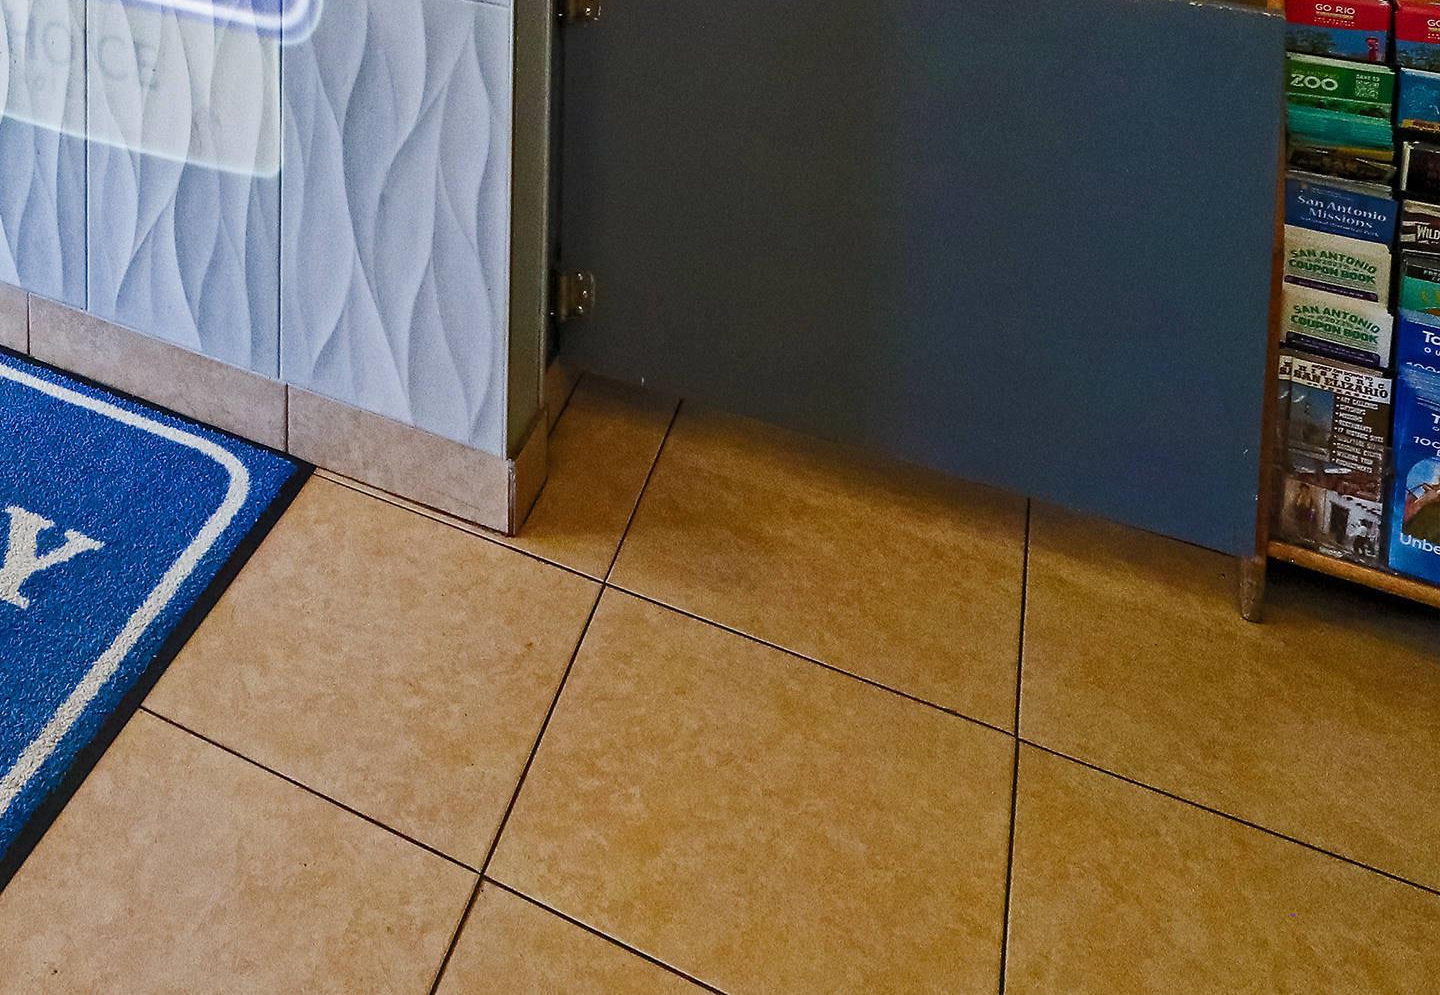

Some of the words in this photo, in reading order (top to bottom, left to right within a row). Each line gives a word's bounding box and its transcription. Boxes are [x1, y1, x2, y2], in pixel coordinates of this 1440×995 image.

[1315, 3, 1332, 12] GO
[1335, 5, 1356, 15] RIO
[1290, 73, 1338, 91] ZOO
[1297, 195, 1324, 208] San
[1326, 201, 1387, 222] Antonio
[1309, 207, 1373, 229] Missions
[1288, 259, 1339, 277] COUPON
[1340, 269, 1376, 285] BOOK
[1290, 248, 1317, 258] SAN
[1319, 250, 1377, 274] ANTONIO
[1291, 314, 1341, 334] COUPON
[1343, 328, 1379, 344] BOOK
[1293, 305, 1320, 314] SAN
[1322, 307, 1381, 334] ANTONIO
[1293, 369, 1321, 384] SAN
